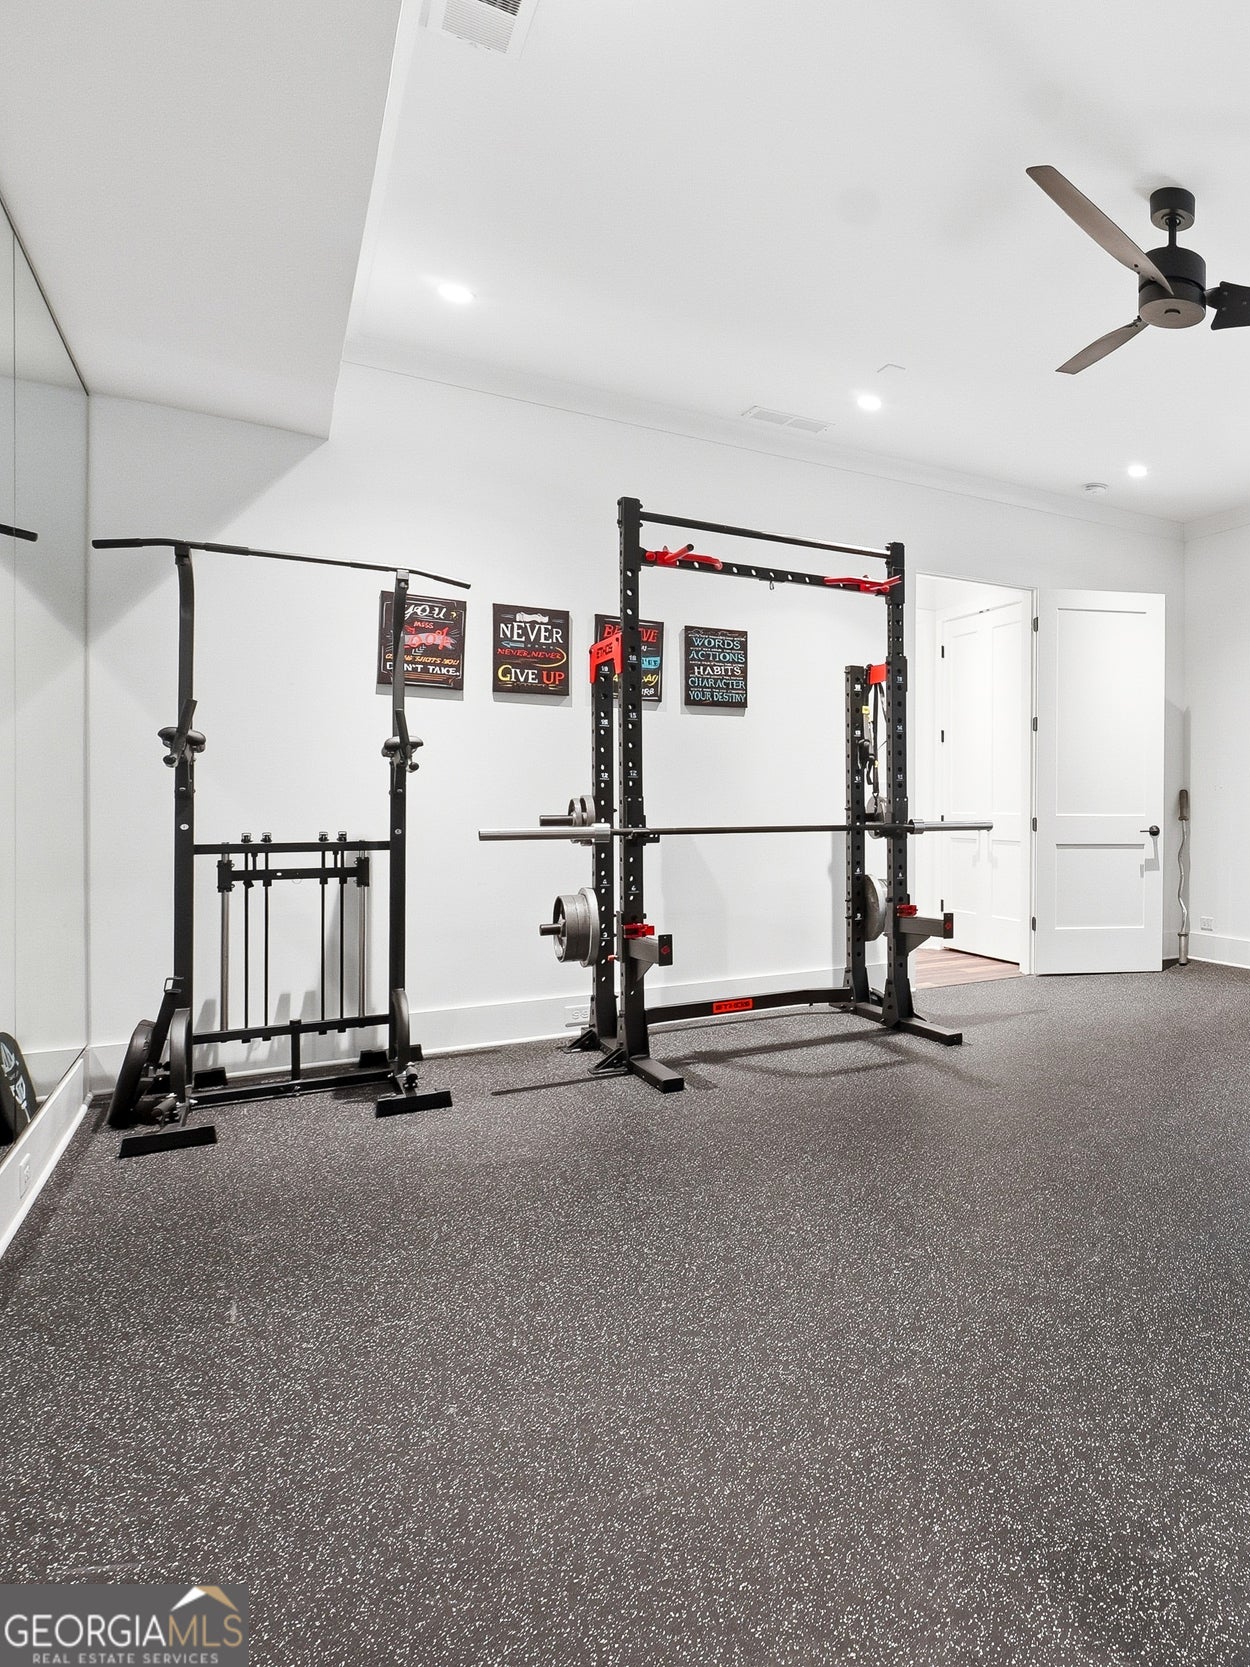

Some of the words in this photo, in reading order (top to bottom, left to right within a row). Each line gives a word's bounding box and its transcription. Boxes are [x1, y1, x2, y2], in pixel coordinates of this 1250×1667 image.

[499, 621, 563, 643] NEVER
[692, 637, 741, 650] WORDS
[689, 651, 745, 663] ACTIONS
[498, 664, 538, 683] GIVE
[542, 670, 565, 685] UP
[694, 665, 741, 676] HABITS
[688, 677, 746, 689] CHARACTER
[689, 690, 712, 701] YOUR
[713, 691, 746, 703] DESTINY
